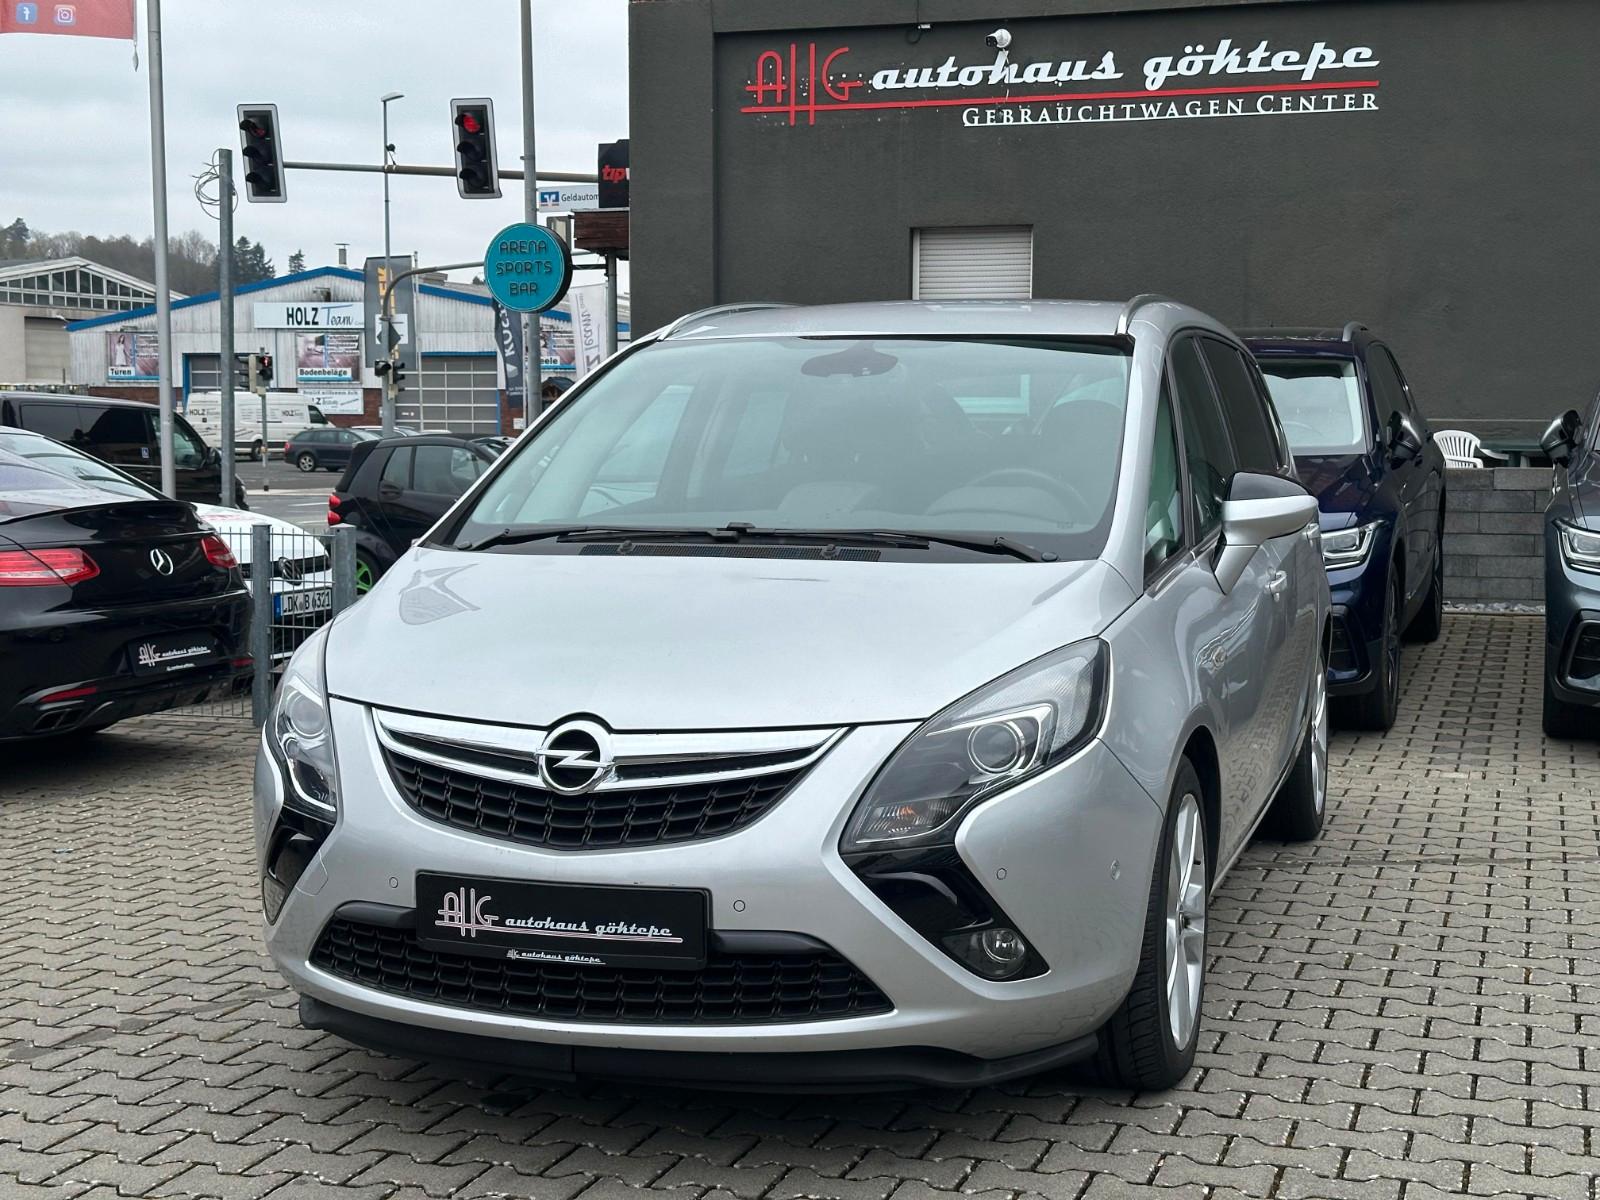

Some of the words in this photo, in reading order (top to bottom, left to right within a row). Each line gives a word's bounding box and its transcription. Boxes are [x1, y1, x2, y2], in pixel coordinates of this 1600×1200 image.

[872, 48, 1123, 90] autohaus
[1143, 38, 1381, 91] göktepe
[1256, 93, 1379, 115] CENTER
[500, 240, 547, 255] ARENA
[496, 261, 552, 275] SPORTS
[509, 282, 539, 297] BAR
[286, 307, 319, 326] HOLZ
[321, 304, 353, 326] Team
[304, 594, 310, 610] B
[435, 886, 500, 938] AHG
[505, 915, 590, 932] autohaus
[595, 921, 673, 938] göktepe
[521, 951, 562, 960] autohaus
